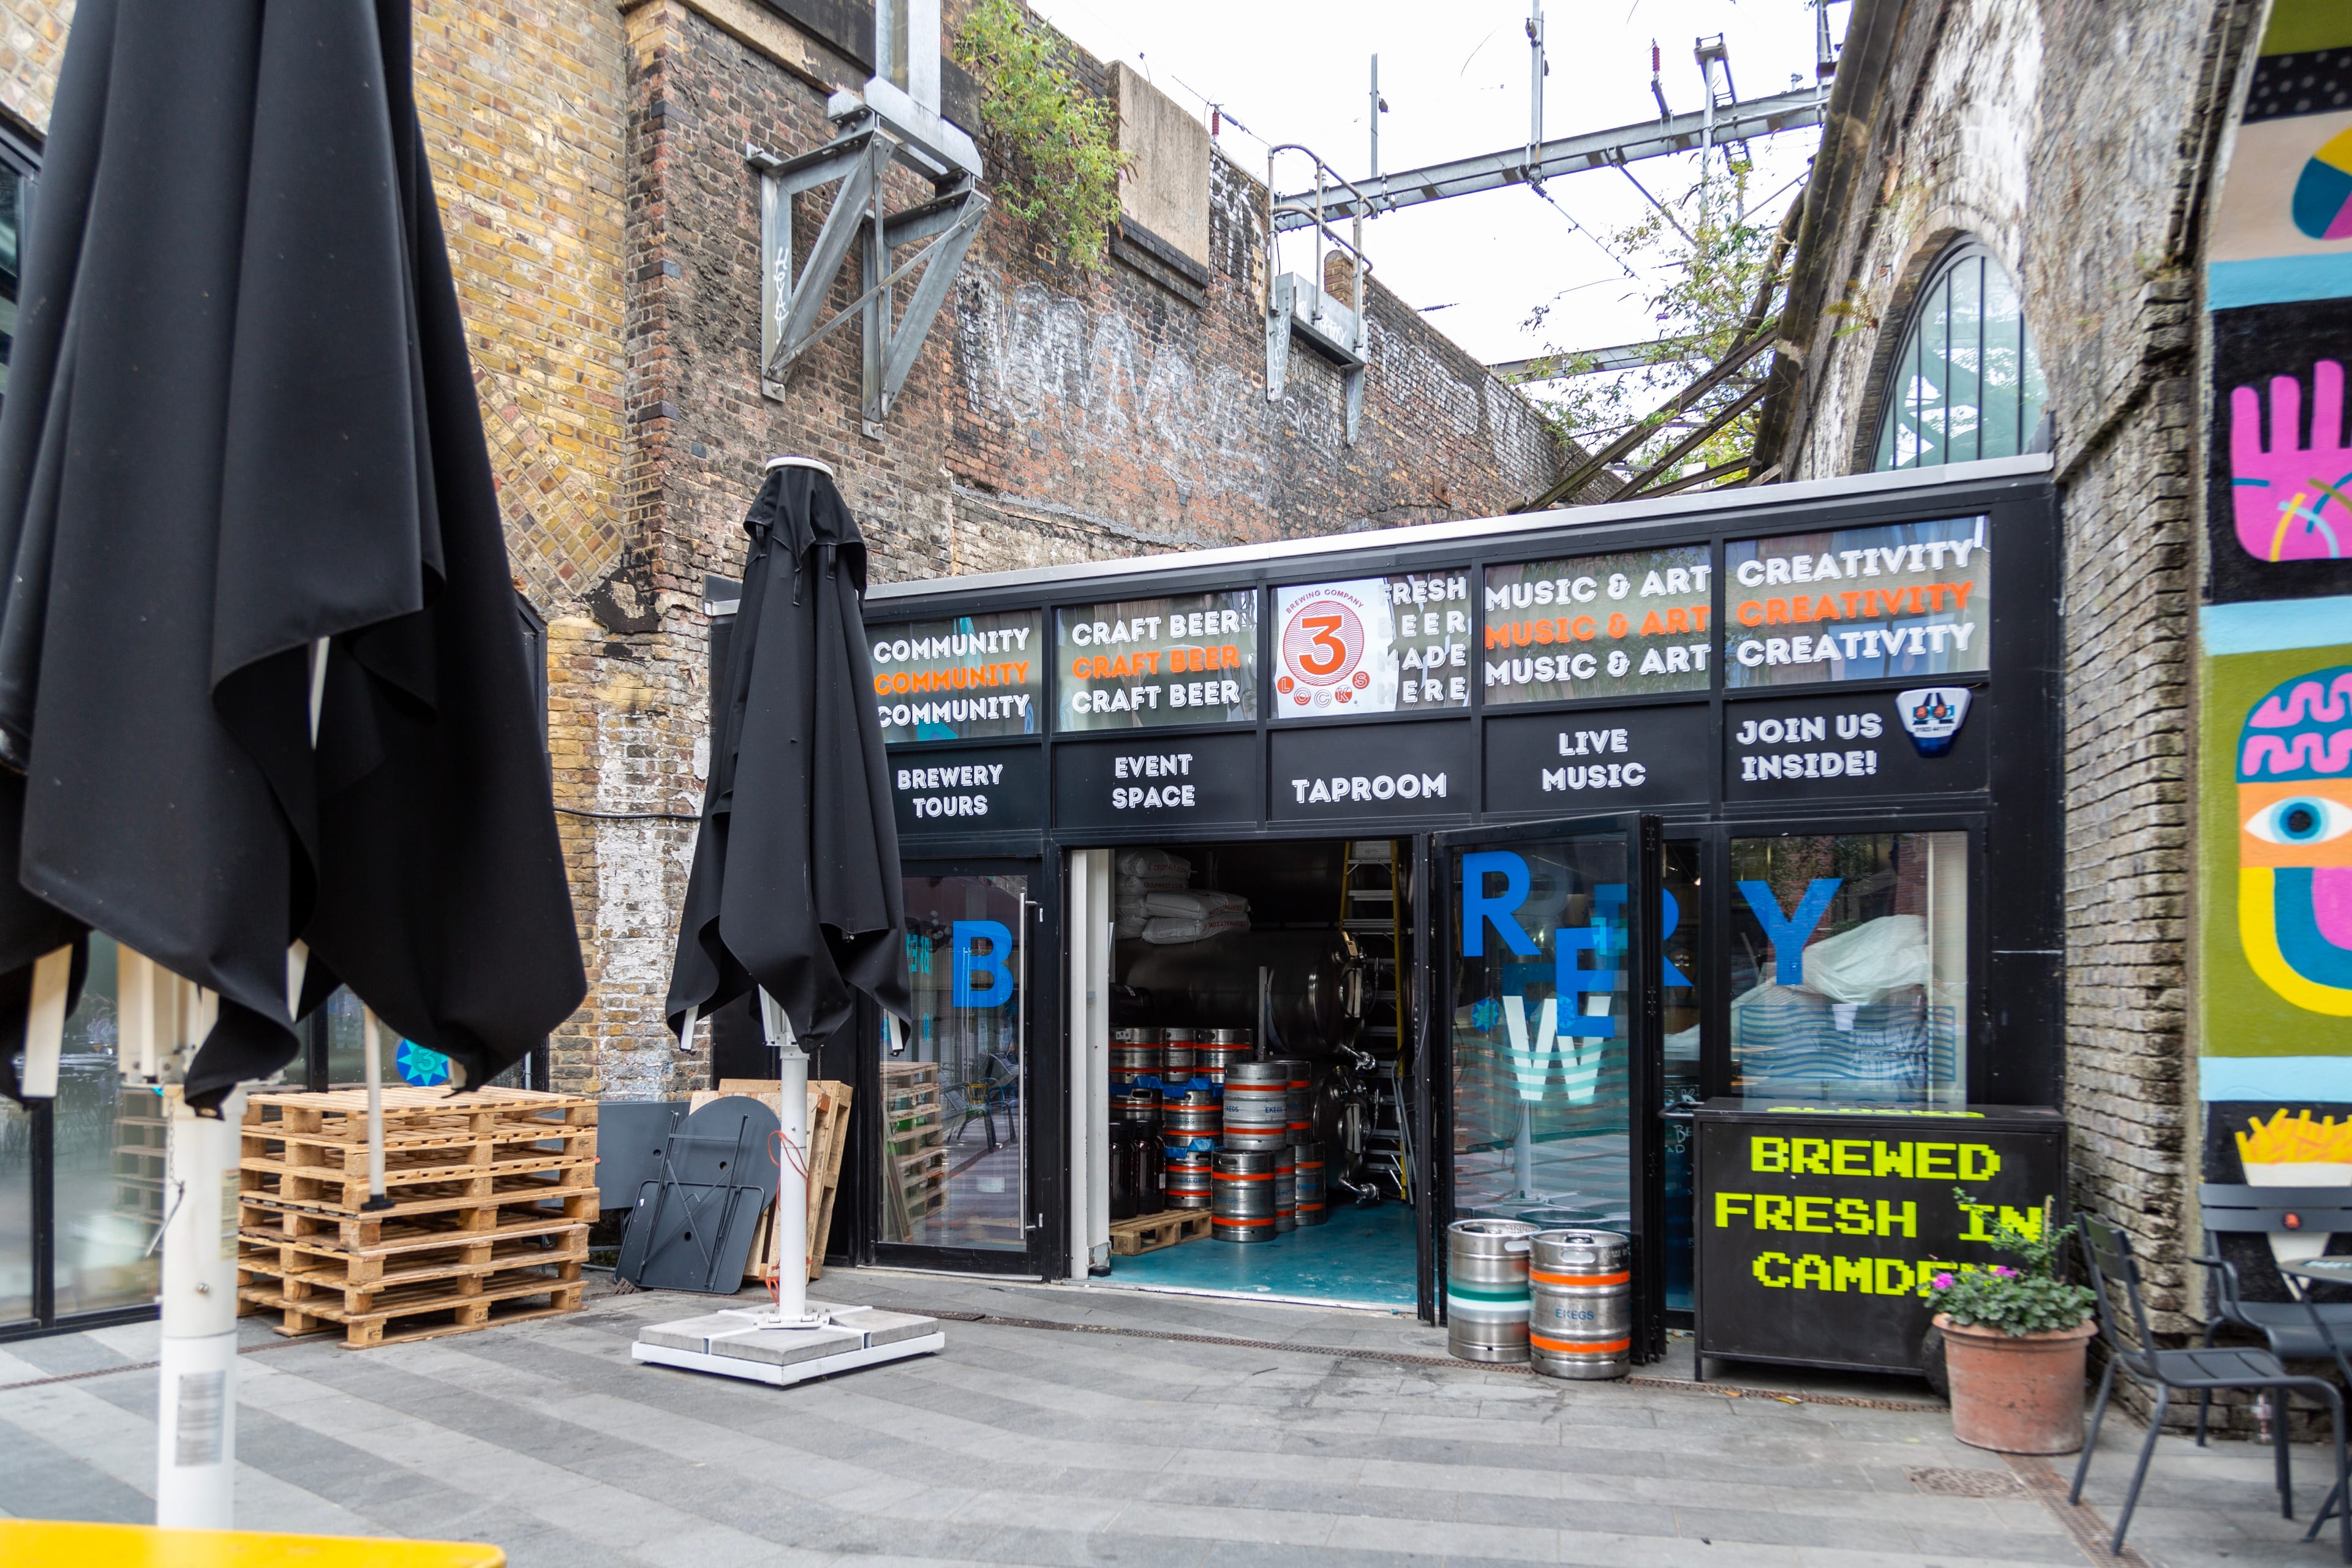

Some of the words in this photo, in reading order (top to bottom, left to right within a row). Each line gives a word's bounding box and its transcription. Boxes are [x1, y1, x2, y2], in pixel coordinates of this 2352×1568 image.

[1737, 538, 1975, 588] CREATIVITY
[1286, 589, 1321, 614] BREWING
[1324, 589, 1364, 608] COMPANY
[1485, 576, 1597, 612] MUSIC
[1607, 573, 1630, 601] &
[1639, 565, 1712, 597] ART
[1737, 581, 1973, 627] CREATIVITY
[873, 627, 1030, 663] COMMUNITY
[1072, 616, 1161, 646] CRAFT
[1169, 609, 1240, 638] BEER
[1485, 614, 1597, 650] MUSIC
[1607, 612, 1629, 639] &
[1640, 605, 1711, 636] ART
[1737, 622, 1975, 668] CREATIVITY
[1072, 652, 1161, 679] CRAFT
[1170, 645, 1240, 673] BEER
[1298, 615, 1347, 676] 3
[1379, 643, 1466, 672] MADE
[874, 661, 1030, 695] COMMUNITY
[1485, 653, 1597, 687] MUSIC
[1607, 650, 1630, 677] &
[1639, 644, 1712, 674] ART
[1072, 685, 1161, 714] CRAFT
[1169, 680, 1240, 707] BEER
[1278, 671, 1370, 707] LOCKS
[878, 693, 1030, 728] COMMUNITY
[1559, 728, 1629, 756] LIVE
[1736, 716, 1826, 745] JOIN
[1836, 713, 1883, 741] US
[897, 764, 1003, 790] BREWERY
[1115, 753, 1193, 778] EVENT
[1542, 762, 1646, 793] MUSIC
[1741, 750, 1877, 781] INSIDE!
[1112, 785, 1195, 809] SPACE
[1292, 772, 1447, 804] TAPROOM
[913, 795, 988, 818] TOURS
[1462, 851, 1542, 957] R
[1736, 878, 1844, 985] Y
[953, 920, 1014, 1008] B
[1556, 926, 1615, 1038] E
[418, 1049, 437, 1071] 3
[1751, 1137, 2001, 1182] BREWED
[1217, 1196, 1238, 1205] EGS
[1716, 1193, 1917, 1238] FRESH
[1959, 1204, 2043, 1242] IN
[1752, 1251, 1999, 1297] CAMDE
[1555, 1308, 1595, 1321] EKEGS
